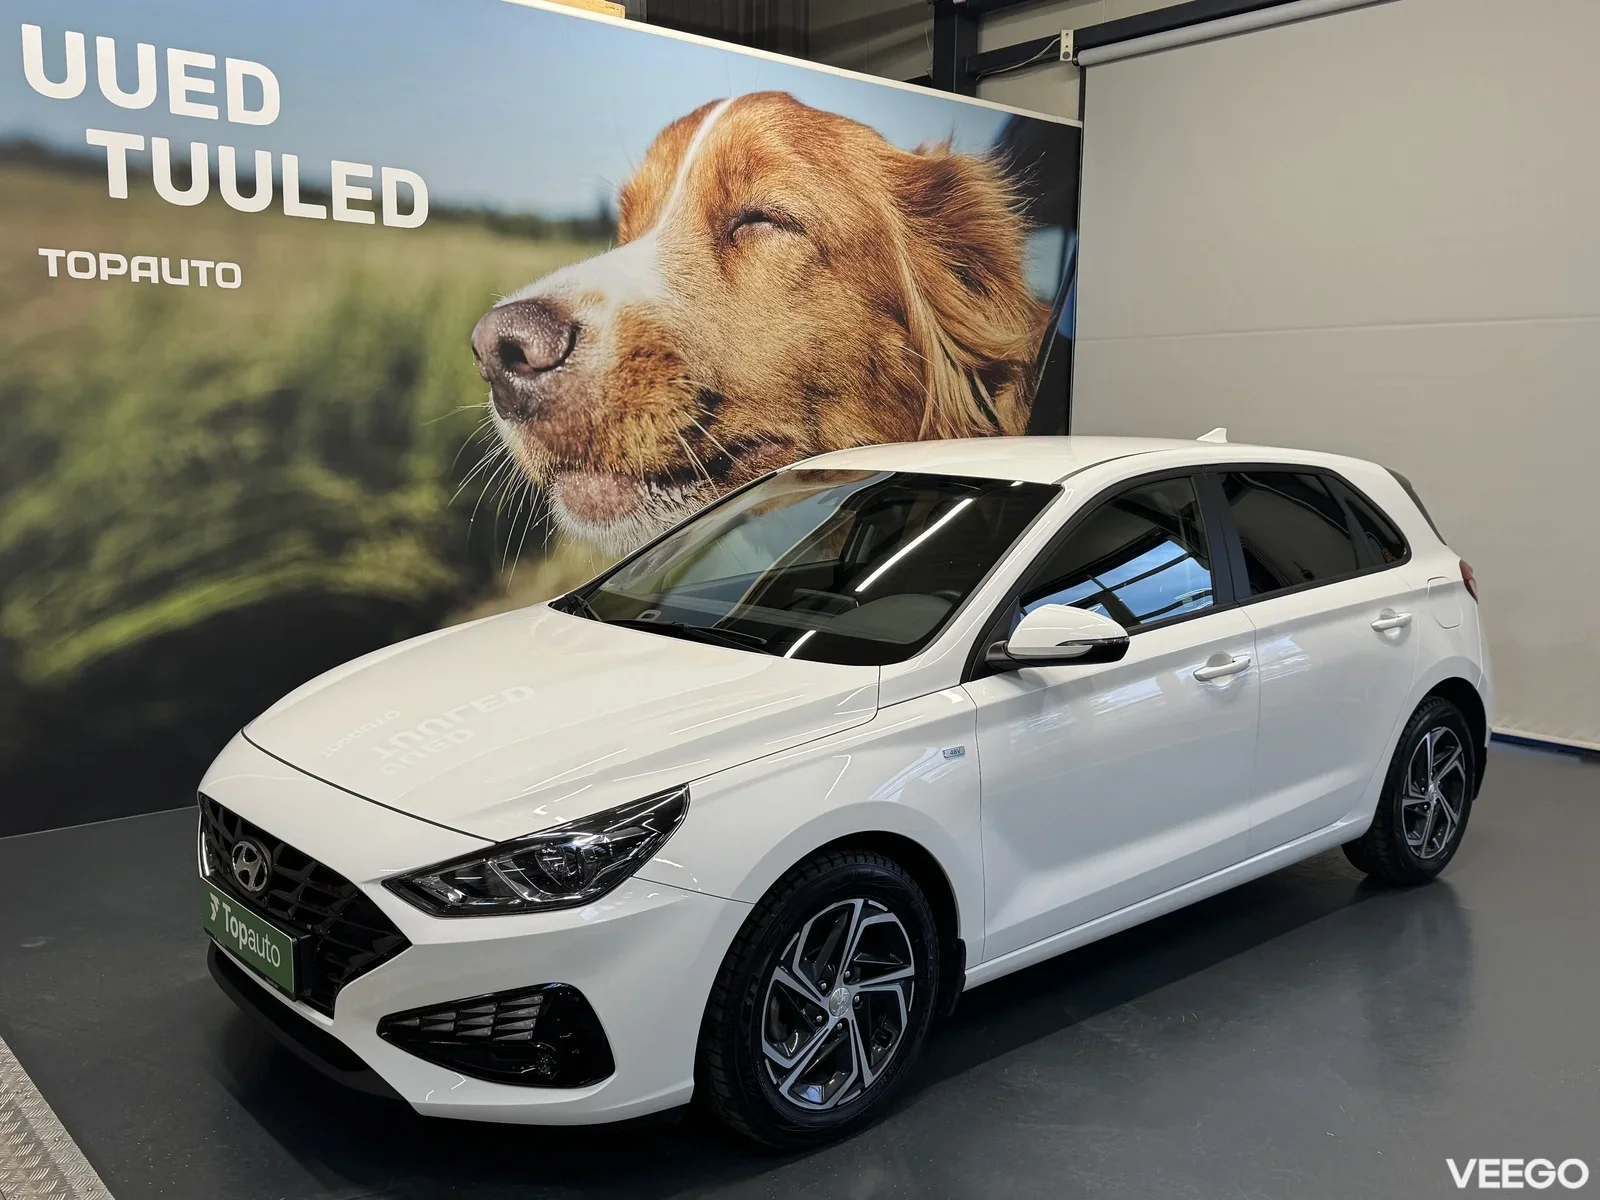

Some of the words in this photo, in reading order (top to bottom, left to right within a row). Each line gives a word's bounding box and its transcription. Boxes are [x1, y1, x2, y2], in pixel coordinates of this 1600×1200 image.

[21, 23, 281, 126] UUED
[86, 128, 429, 229] TUULED
[38, 247, 243, 289] TOPAUTO
[222, 901, 281, 968] Topauto
